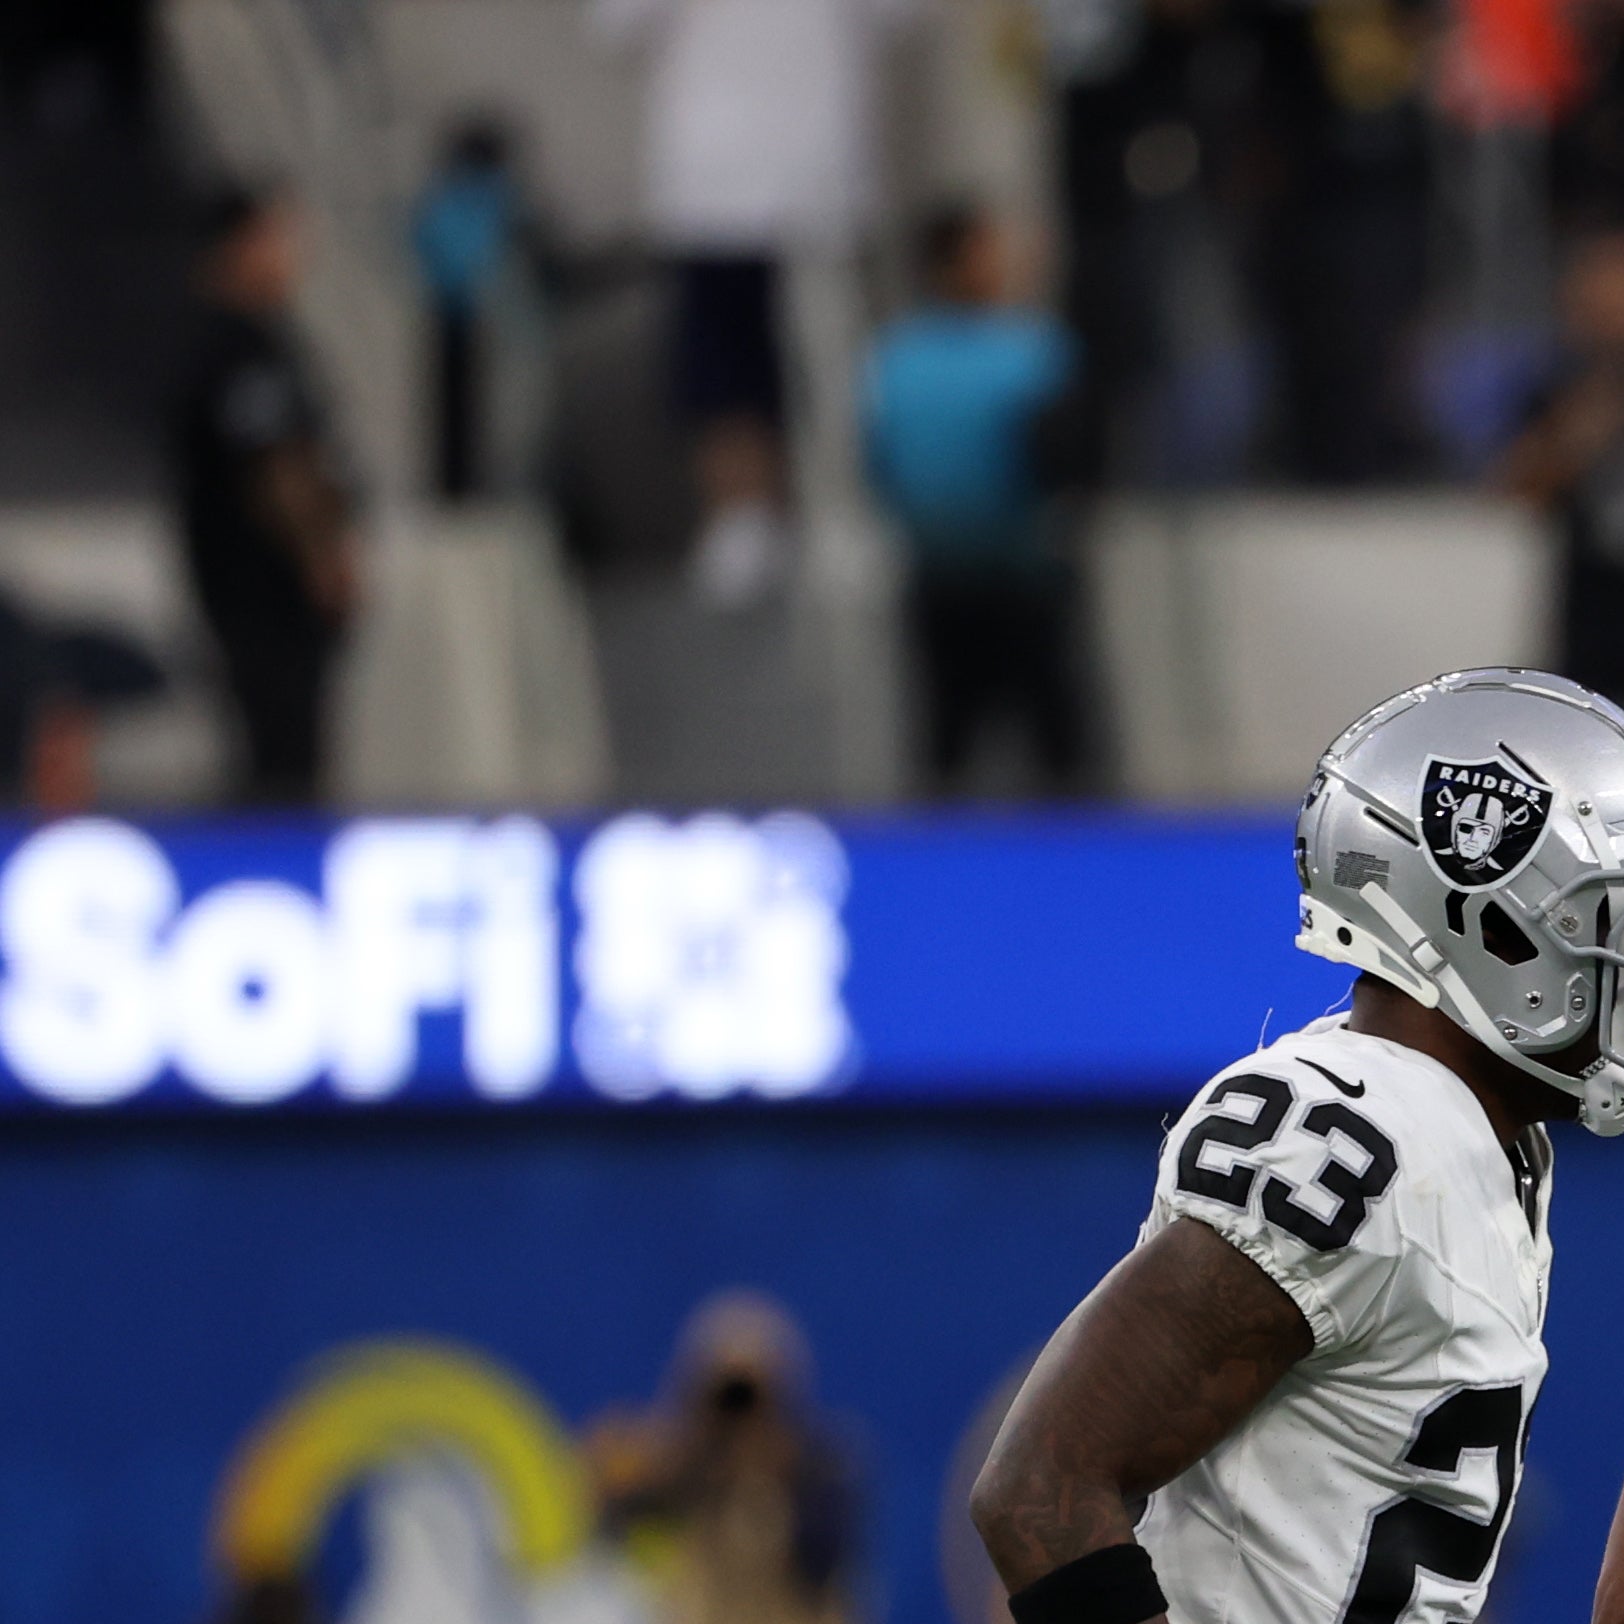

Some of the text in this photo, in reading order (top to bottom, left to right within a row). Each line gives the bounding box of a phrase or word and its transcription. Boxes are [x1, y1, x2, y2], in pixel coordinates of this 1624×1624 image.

[1438, 766, 1541, 802] RAIDERS
[0, 817, 560, 1104] SoFi
[1173, 1071, 1398, 1252] 23
